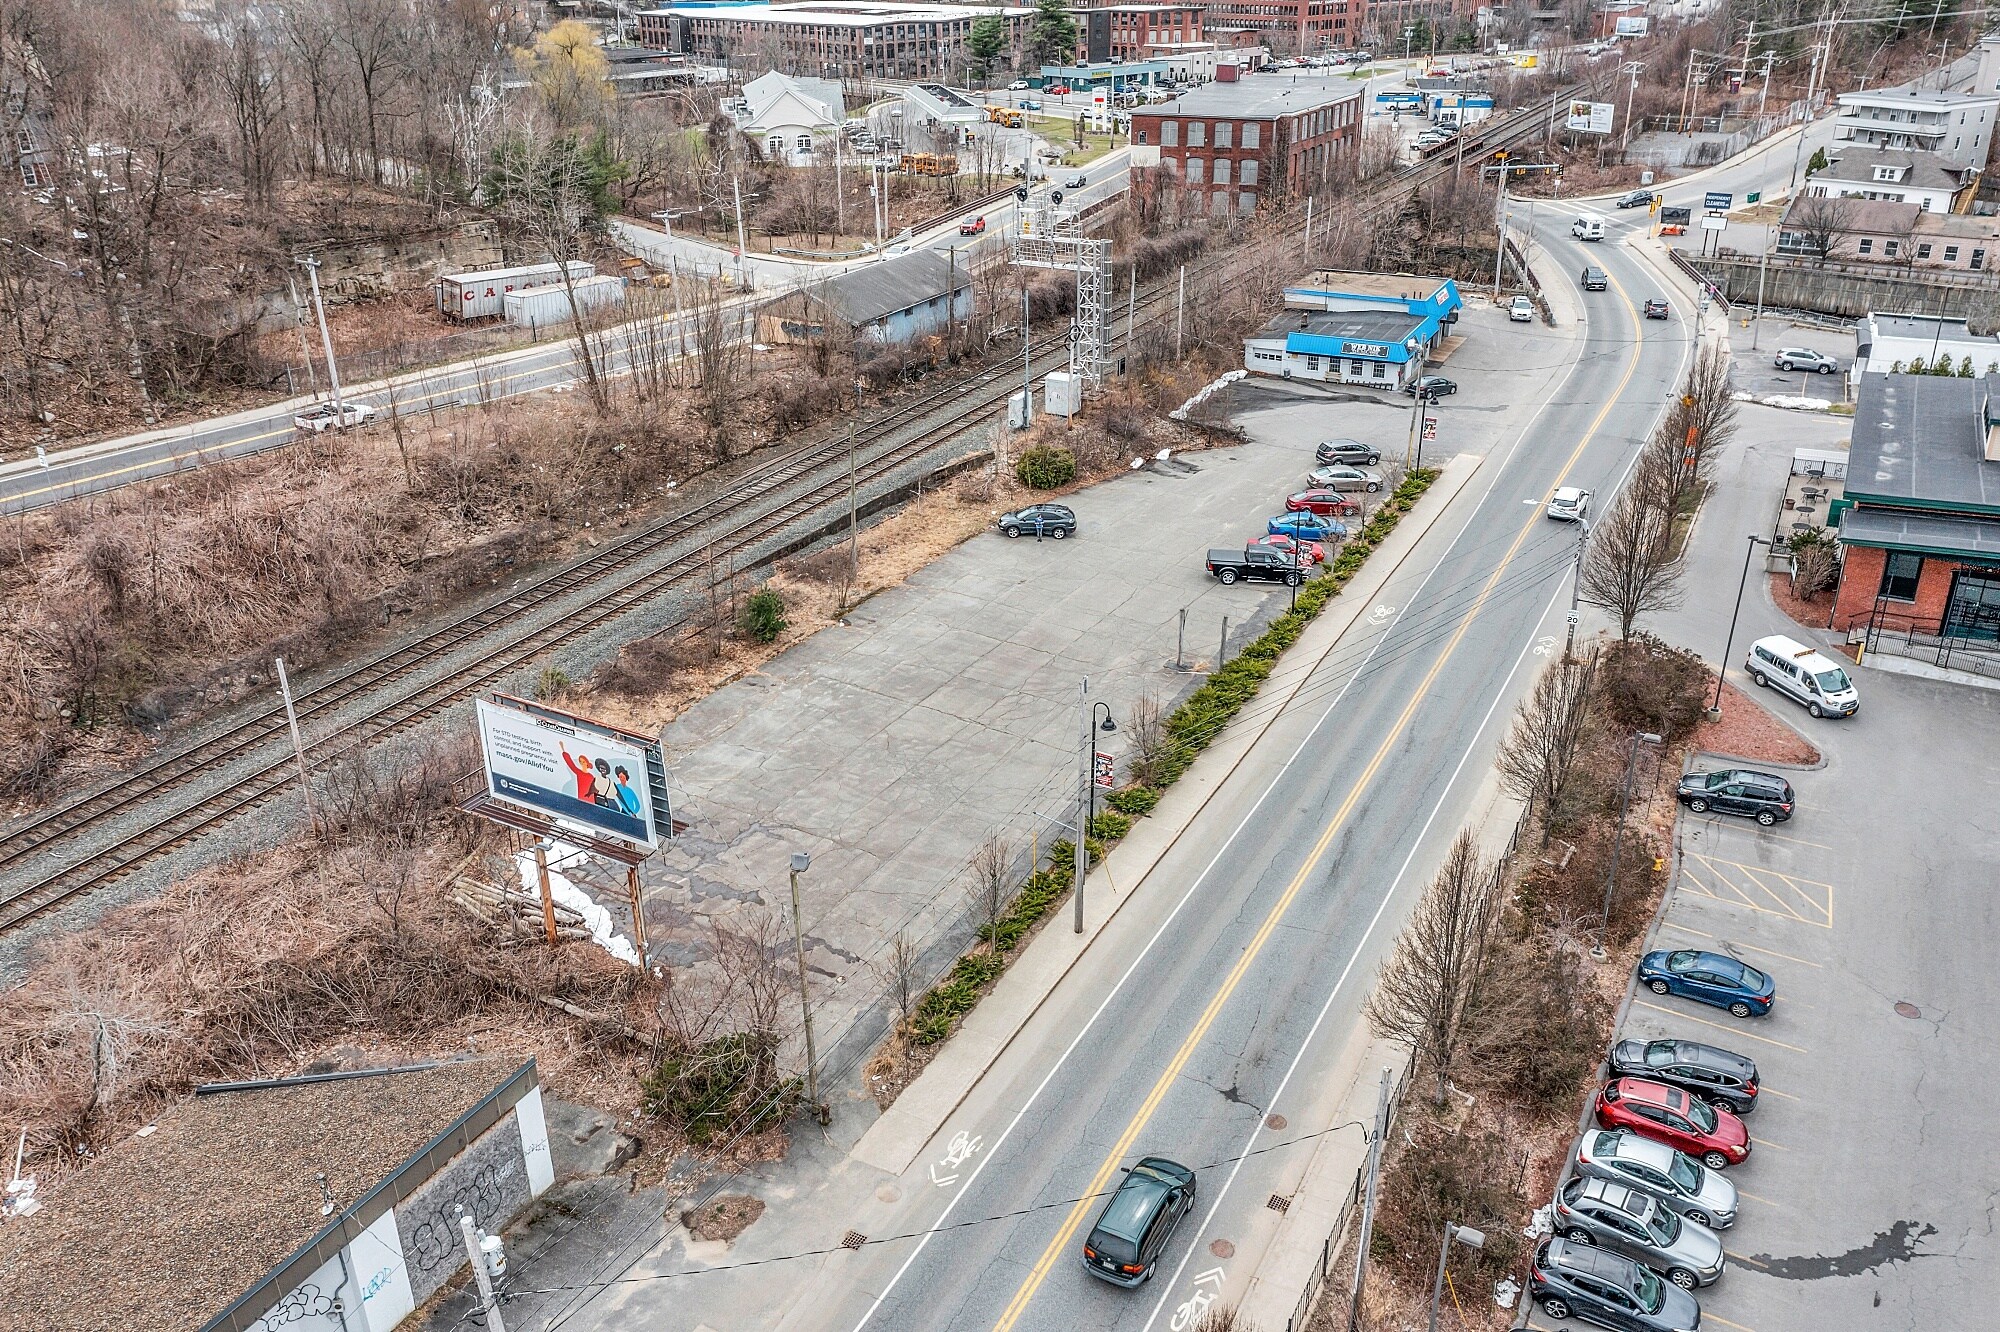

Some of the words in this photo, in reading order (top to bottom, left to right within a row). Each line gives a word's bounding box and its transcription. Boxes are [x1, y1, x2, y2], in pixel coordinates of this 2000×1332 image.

[501, 729, 511, 737] STD
[530, 739, 542, 747] birth
[495, 741, 520, 753] unplanned
[522, 743, 541, 753] support
[496, 750, 554, 773] mass.gov/AllofYou
